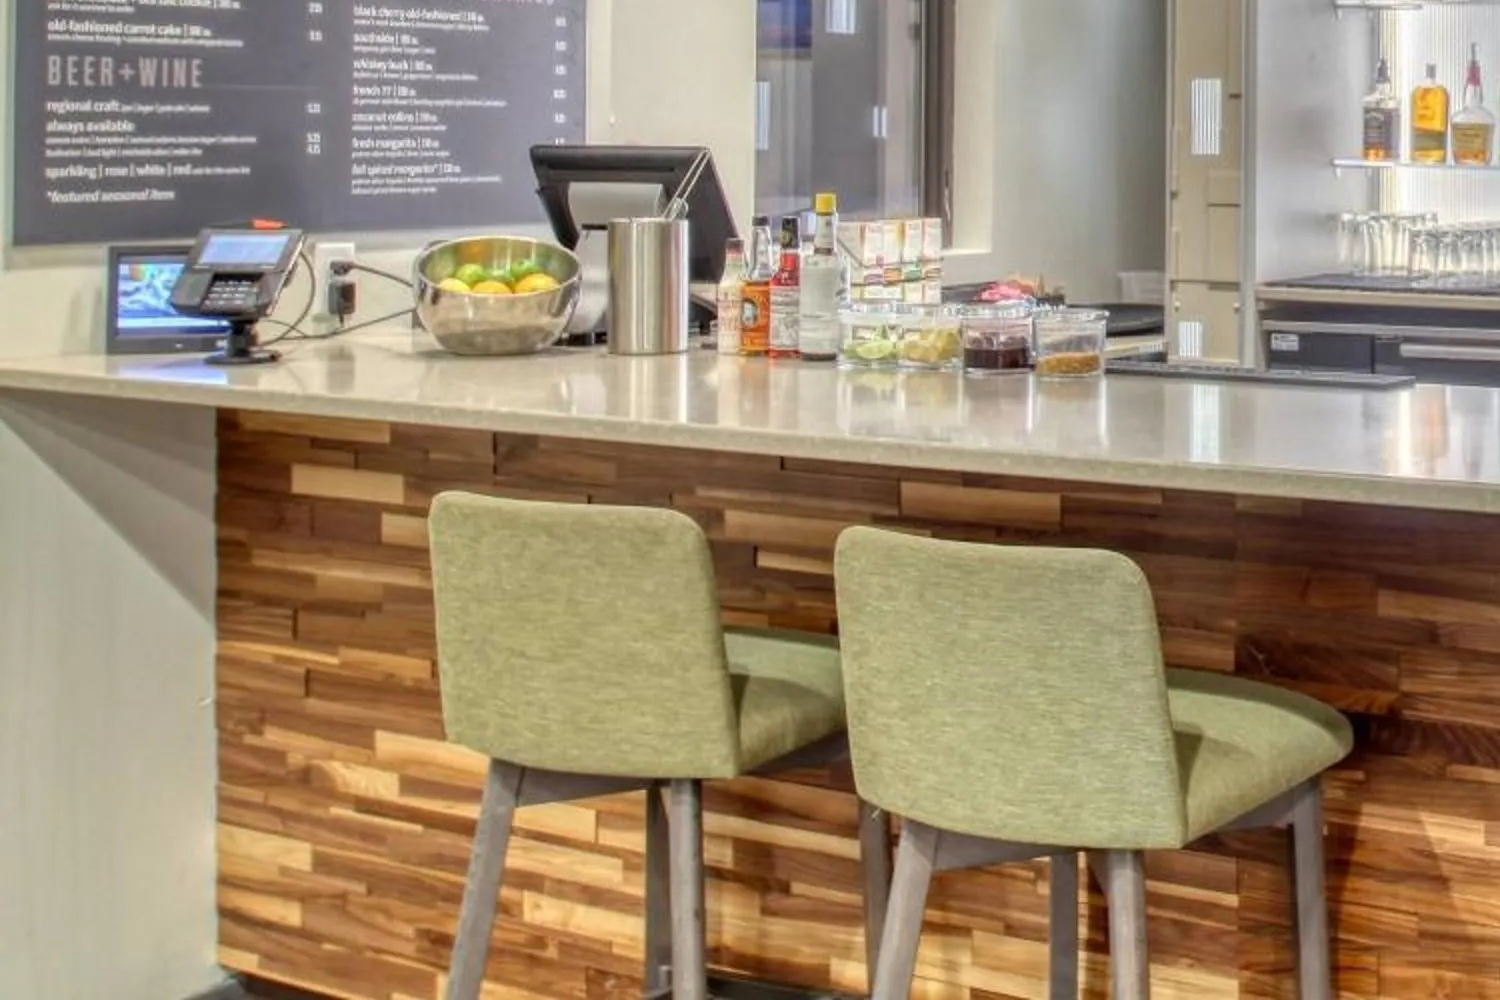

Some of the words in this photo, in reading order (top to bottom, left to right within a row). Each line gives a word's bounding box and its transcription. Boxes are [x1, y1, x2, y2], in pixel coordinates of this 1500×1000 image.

[48, 20, 123, 34] old-fashioned
[158, 25, 182, 36] cake
[48, 55, 203, 88] BEER+WINE
[46, 100, 92, 114] regional
[94, 100, 120, 112] craft
[46, 120, 84, 133] always
[46, 164, 96, 179] sparkling
[136, 165, 165, 176] white
[173, 164, 192, 175] red
